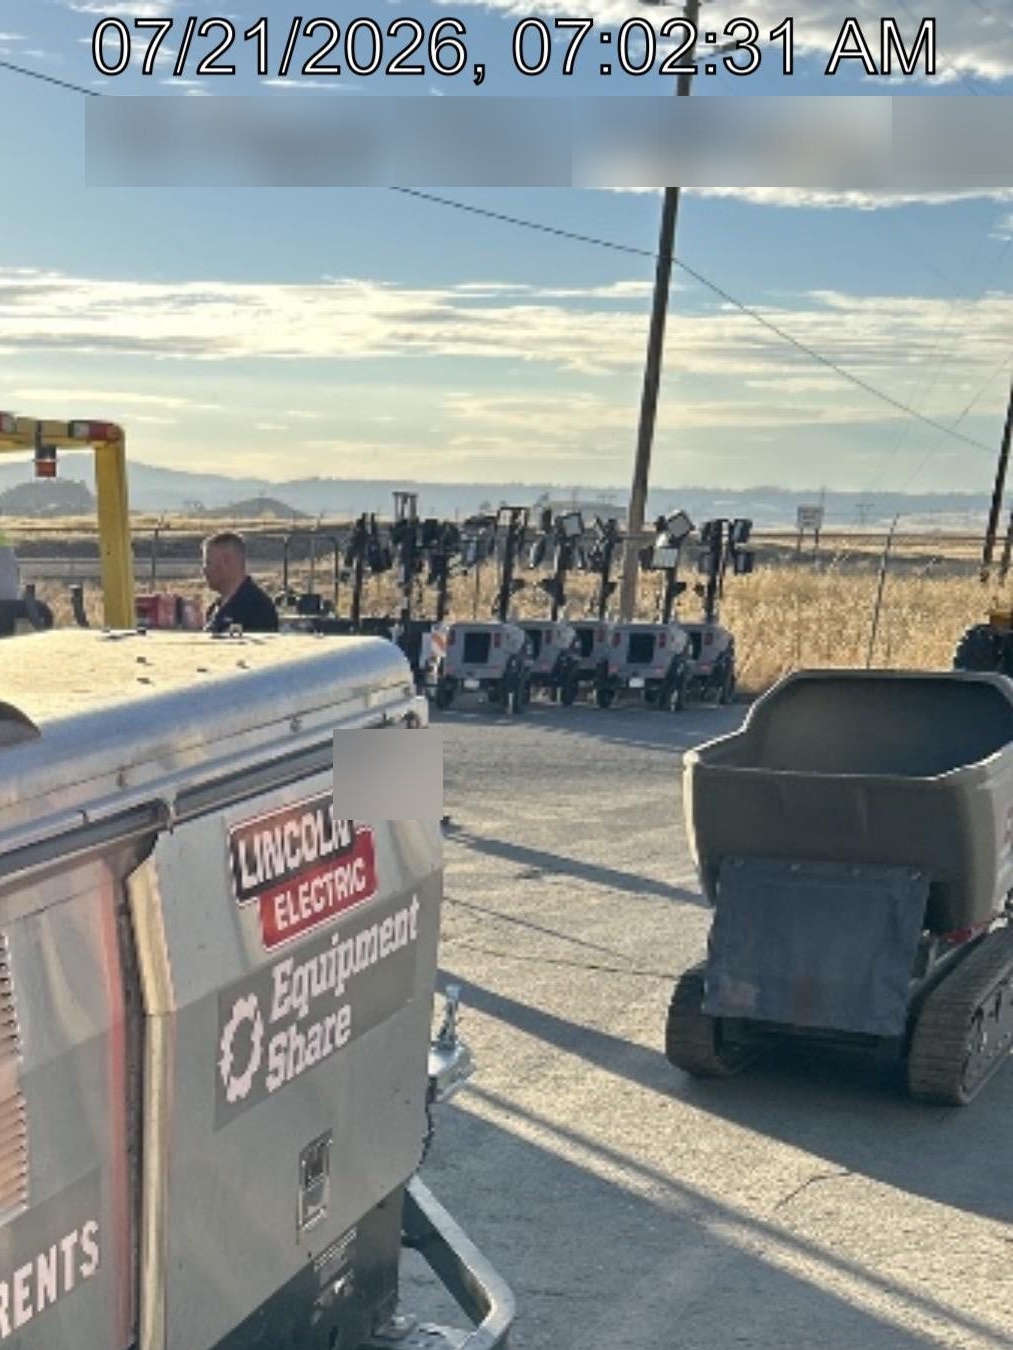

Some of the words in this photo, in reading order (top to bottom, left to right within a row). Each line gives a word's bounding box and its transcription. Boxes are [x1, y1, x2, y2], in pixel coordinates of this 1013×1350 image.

[239, 805, 352, 889] LINCOLN
[274, 857, 367, 931] ELECTRIC
[270, 894, 421, 1024] Equipment
[266, 1004, 352, 1092] Share
